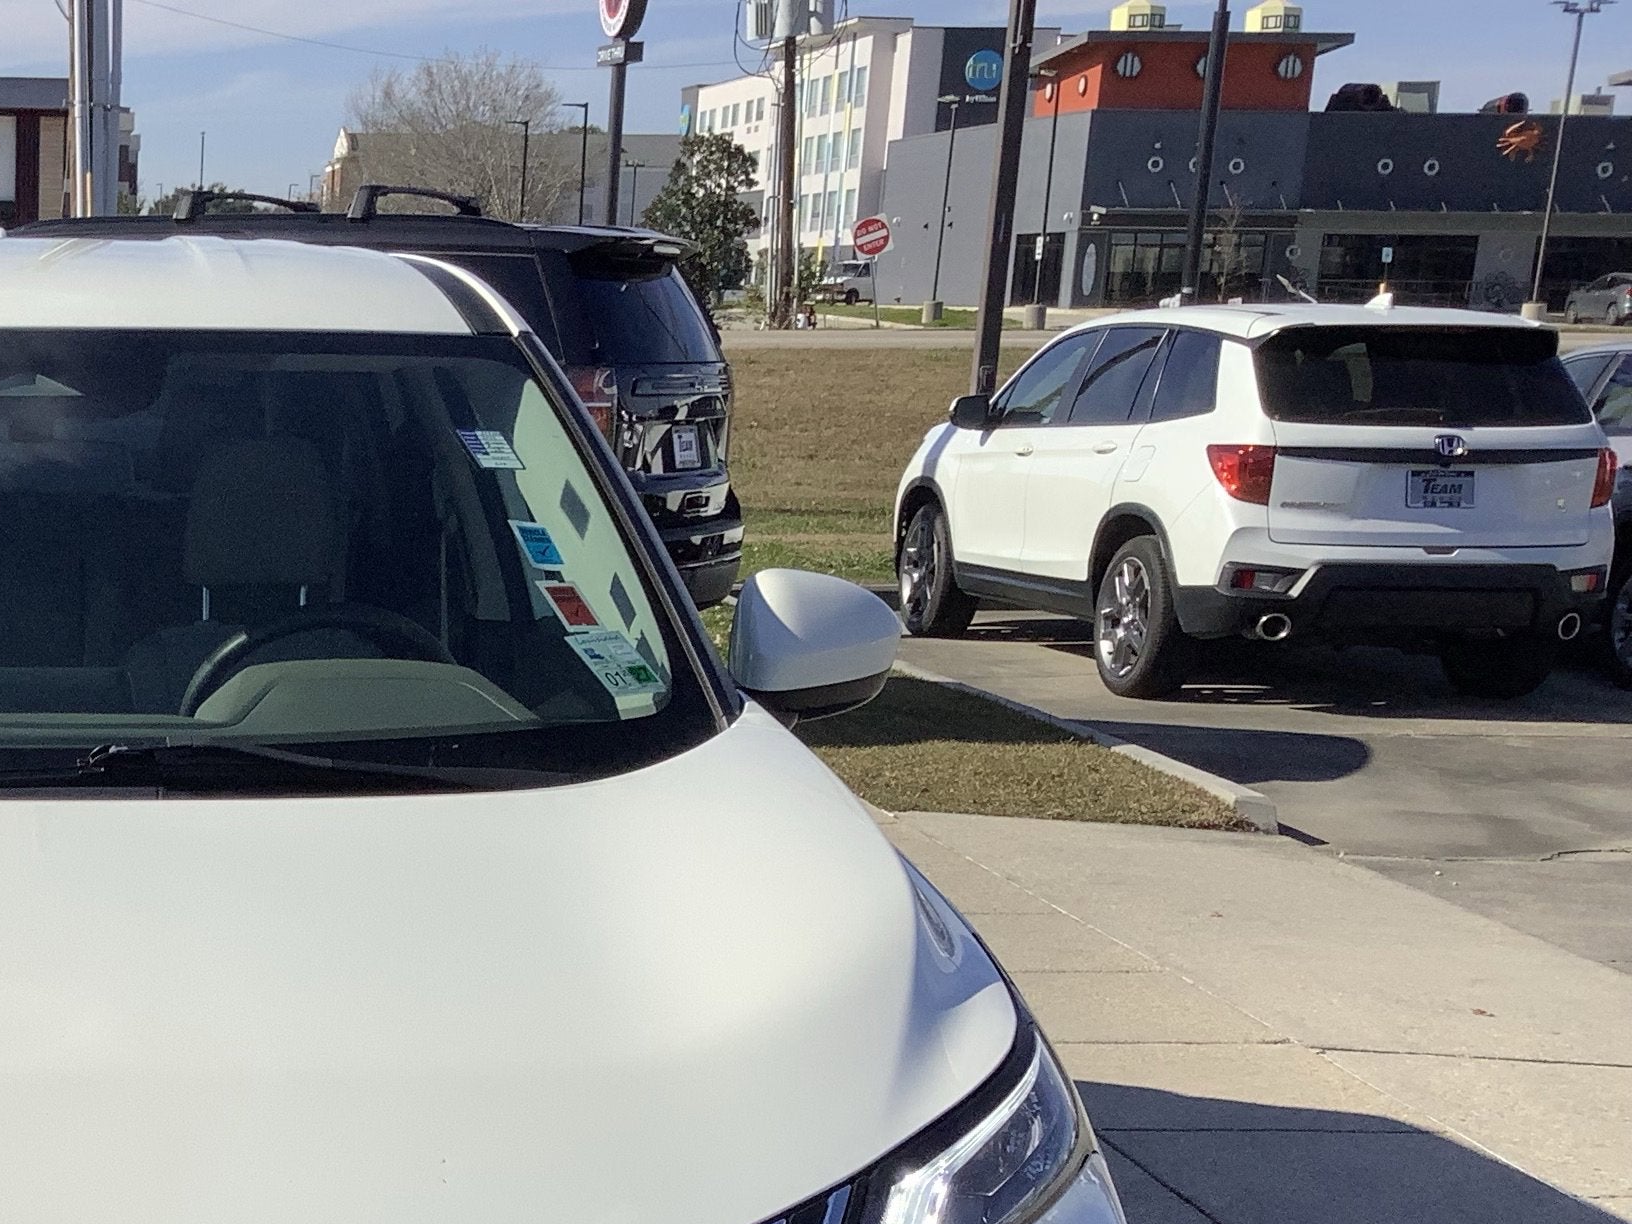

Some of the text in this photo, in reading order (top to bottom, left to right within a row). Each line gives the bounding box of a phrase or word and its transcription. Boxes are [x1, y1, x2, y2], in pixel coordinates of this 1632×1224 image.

[857, 221, 882, 237] DO NOT
[863, 238, 885, 251] ENTER
[605, 671, 628, 687] 01
